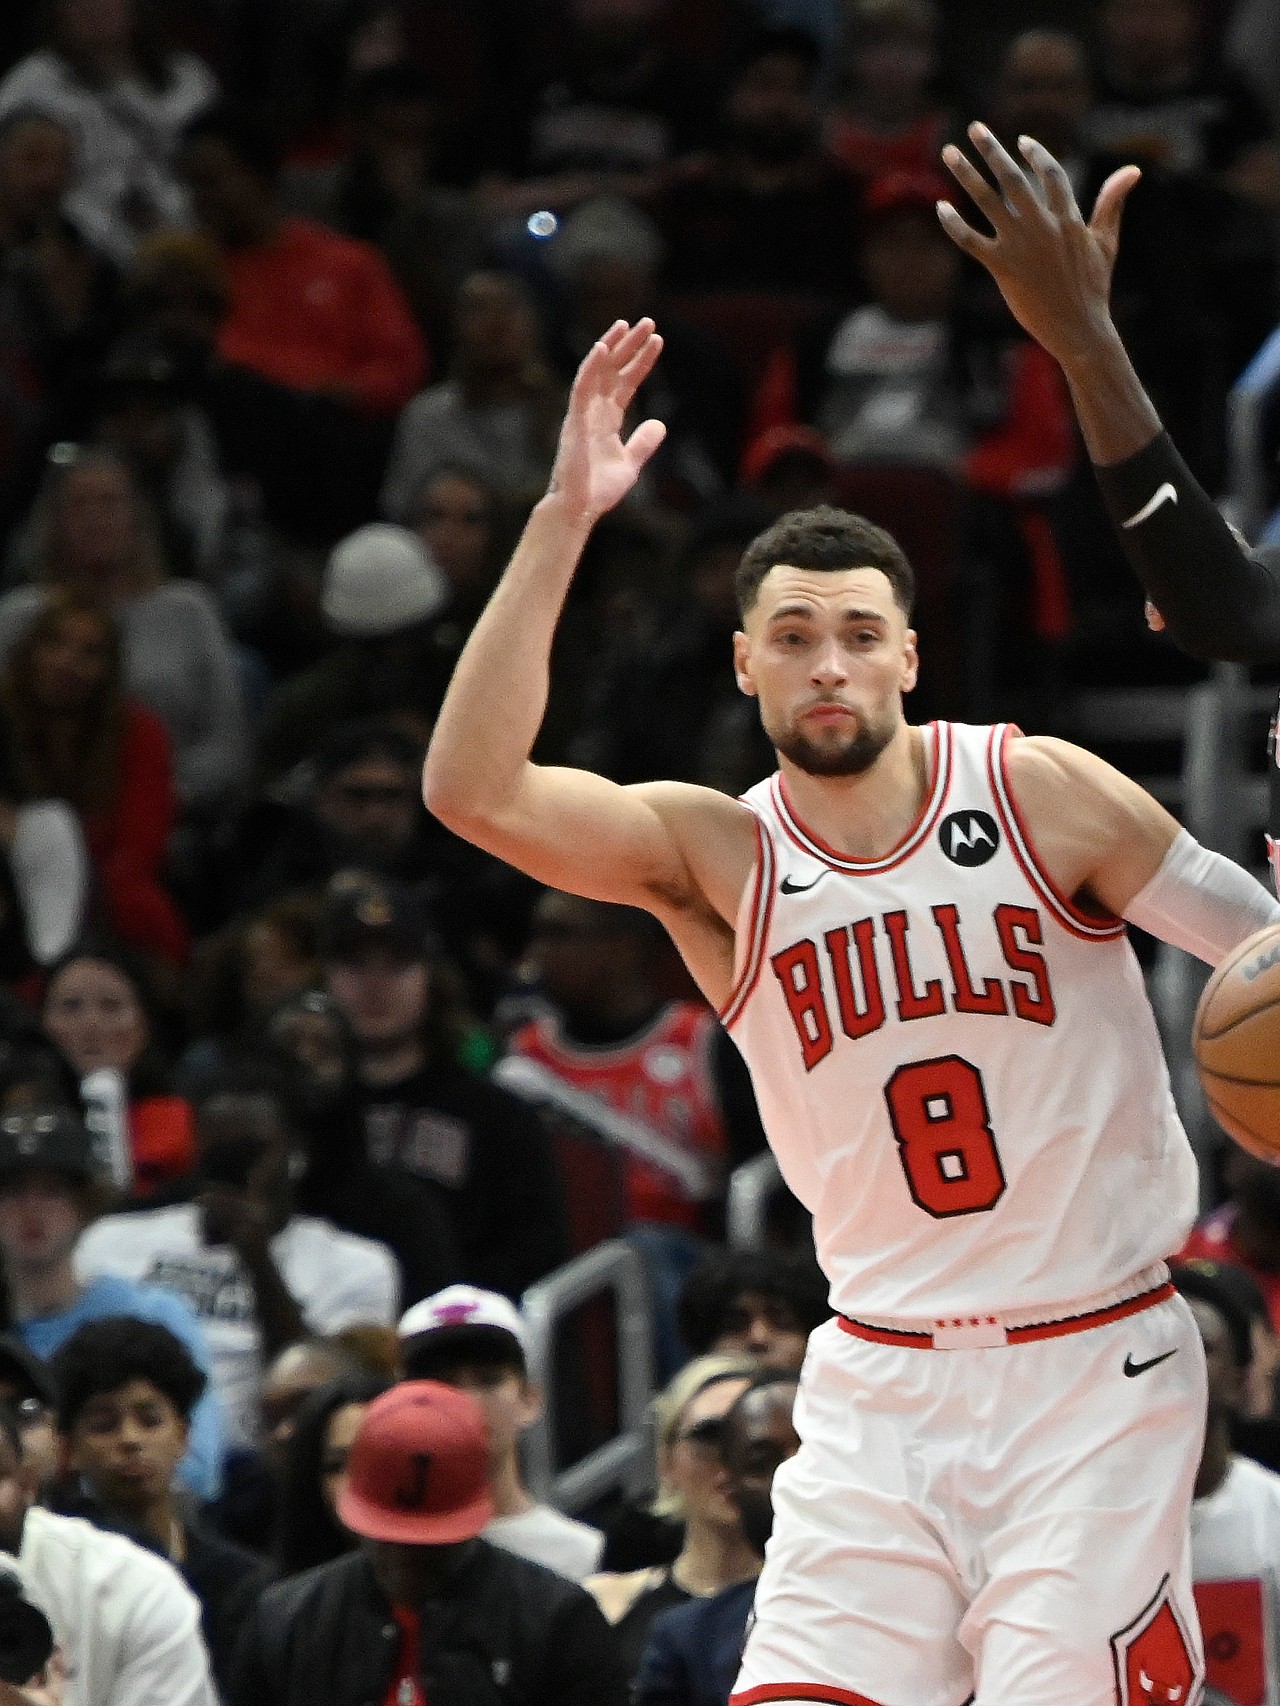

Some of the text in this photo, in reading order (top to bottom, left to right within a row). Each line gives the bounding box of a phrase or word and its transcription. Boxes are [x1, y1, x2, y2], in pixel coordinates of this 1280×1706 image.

[770, 903, 1056, 1073] BULLS
[883, 1053, 1008, 1219] 8
[394, 1452, 434, 1508] J
